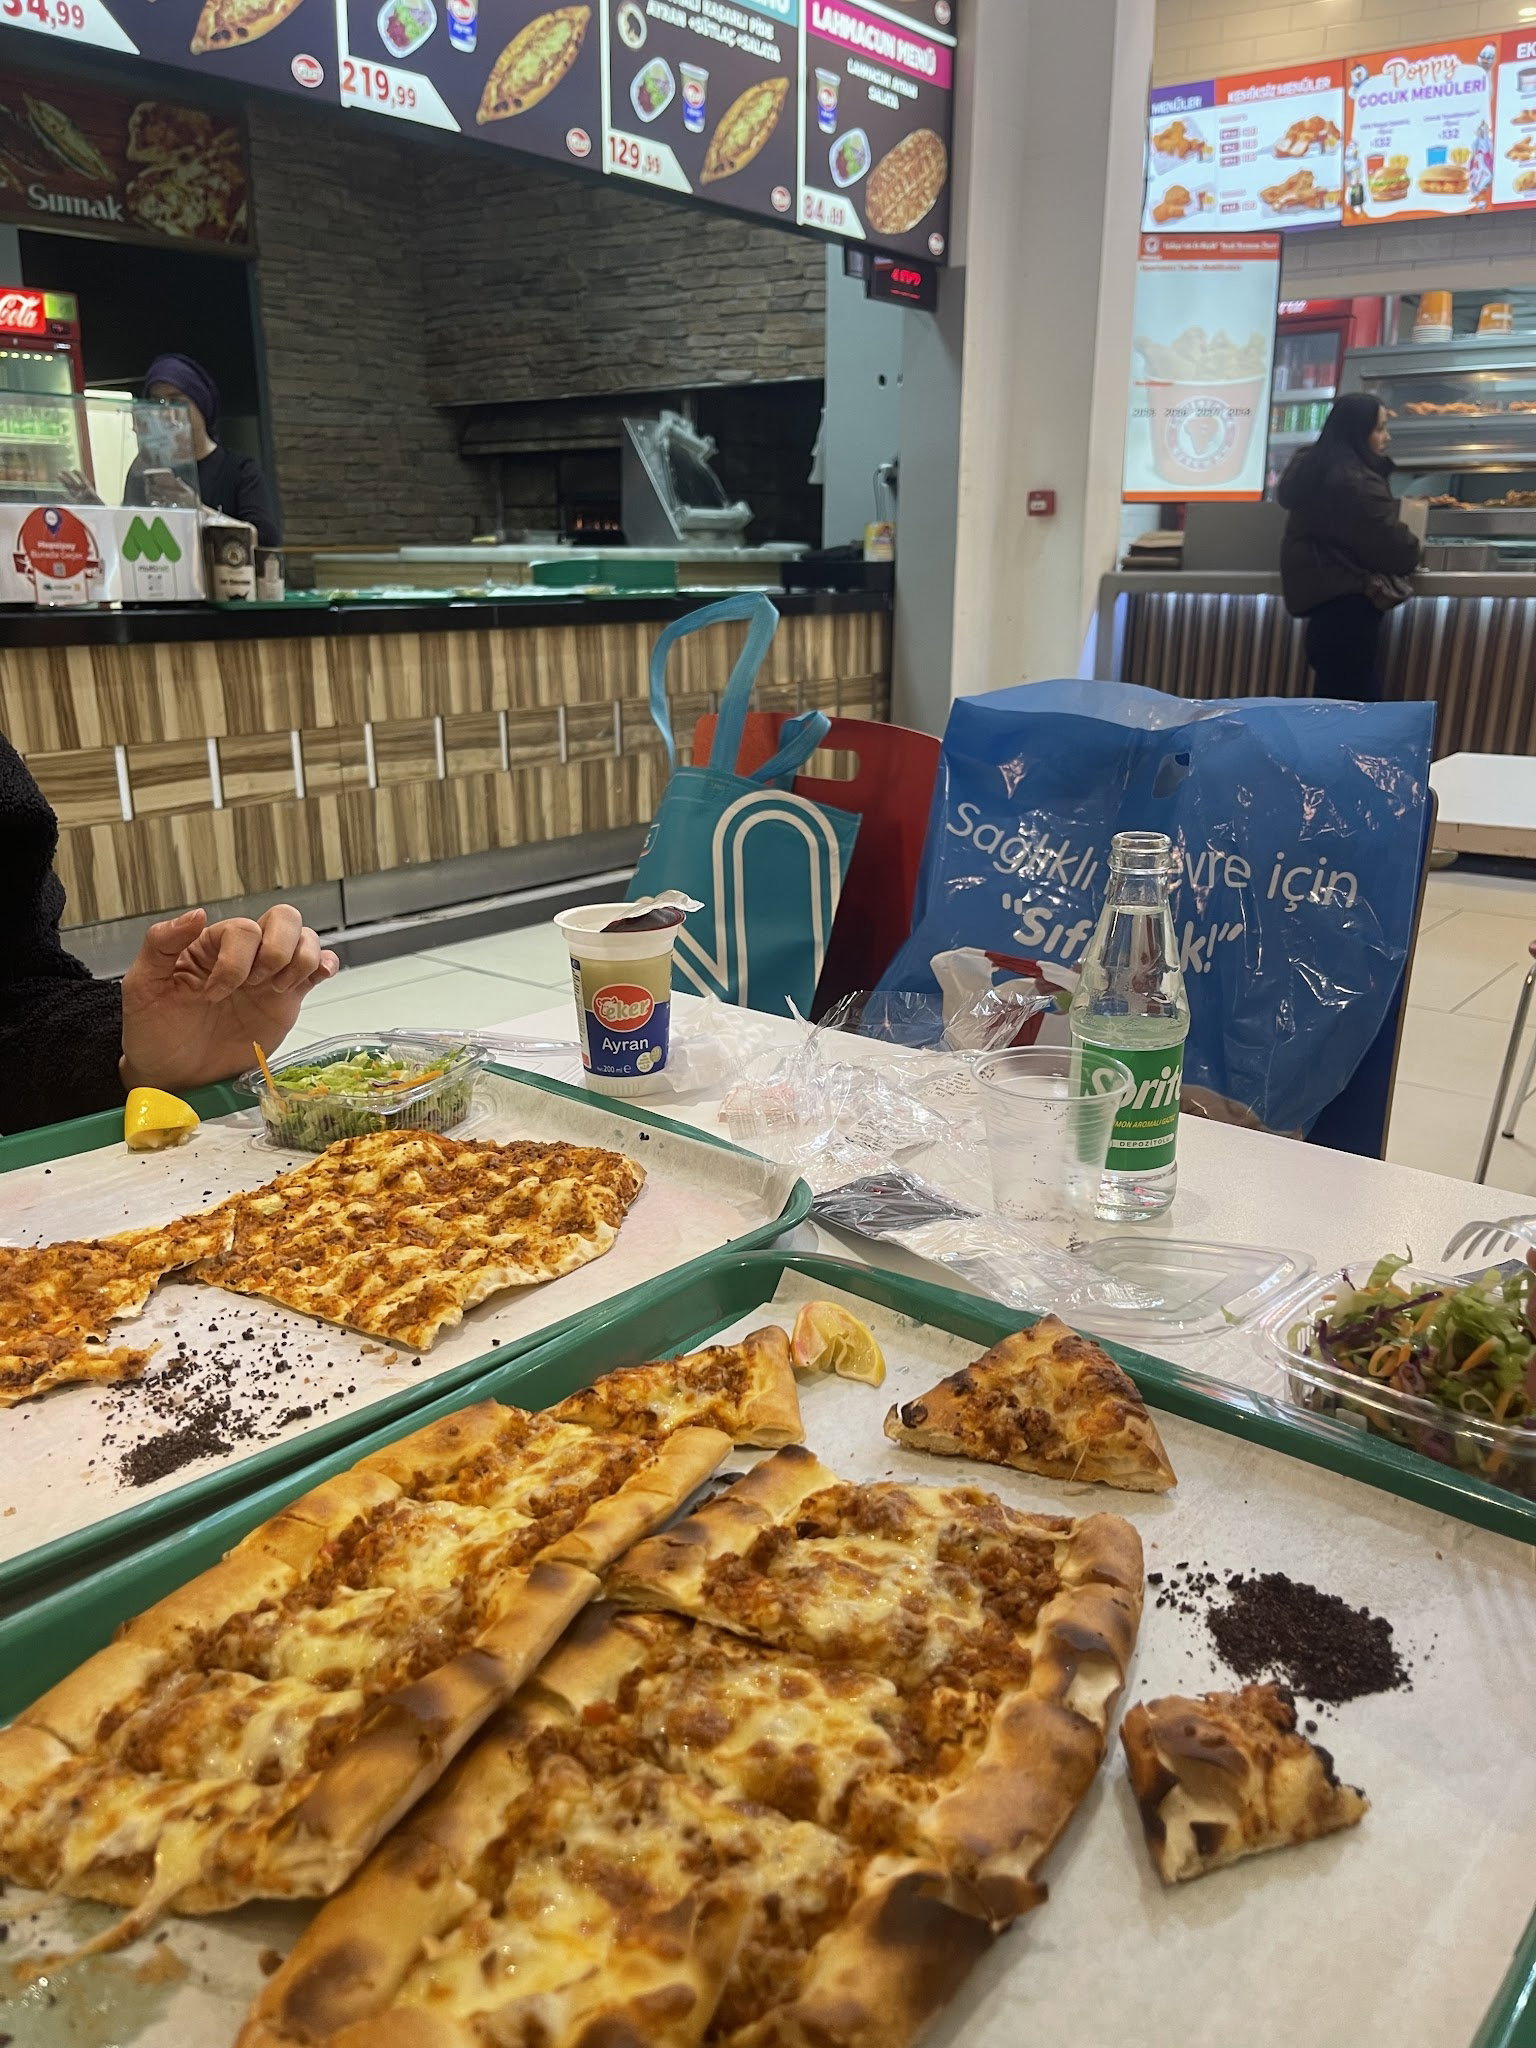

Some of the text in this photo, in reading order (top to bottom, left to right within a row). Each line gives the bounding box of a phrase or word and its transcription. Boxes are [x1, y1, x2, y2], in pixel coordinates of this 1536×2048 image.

[811, 1, 937, 76] LAHMACUN MENÜ
[341, 61, 416, 108] 219,99
[1386, 56, 1457, 88] Poppy
[1357, 76, 1487, 110] ÇOCUK MENÜLERİ
[27, 184, 125, 223] Sumak
[1267, 852, 1359, 914] için
[605, 998, 651, 1023] eker
[601, 1036, 649, 1055] Ayran
[1113, 1120, 1132, 1129] MON
